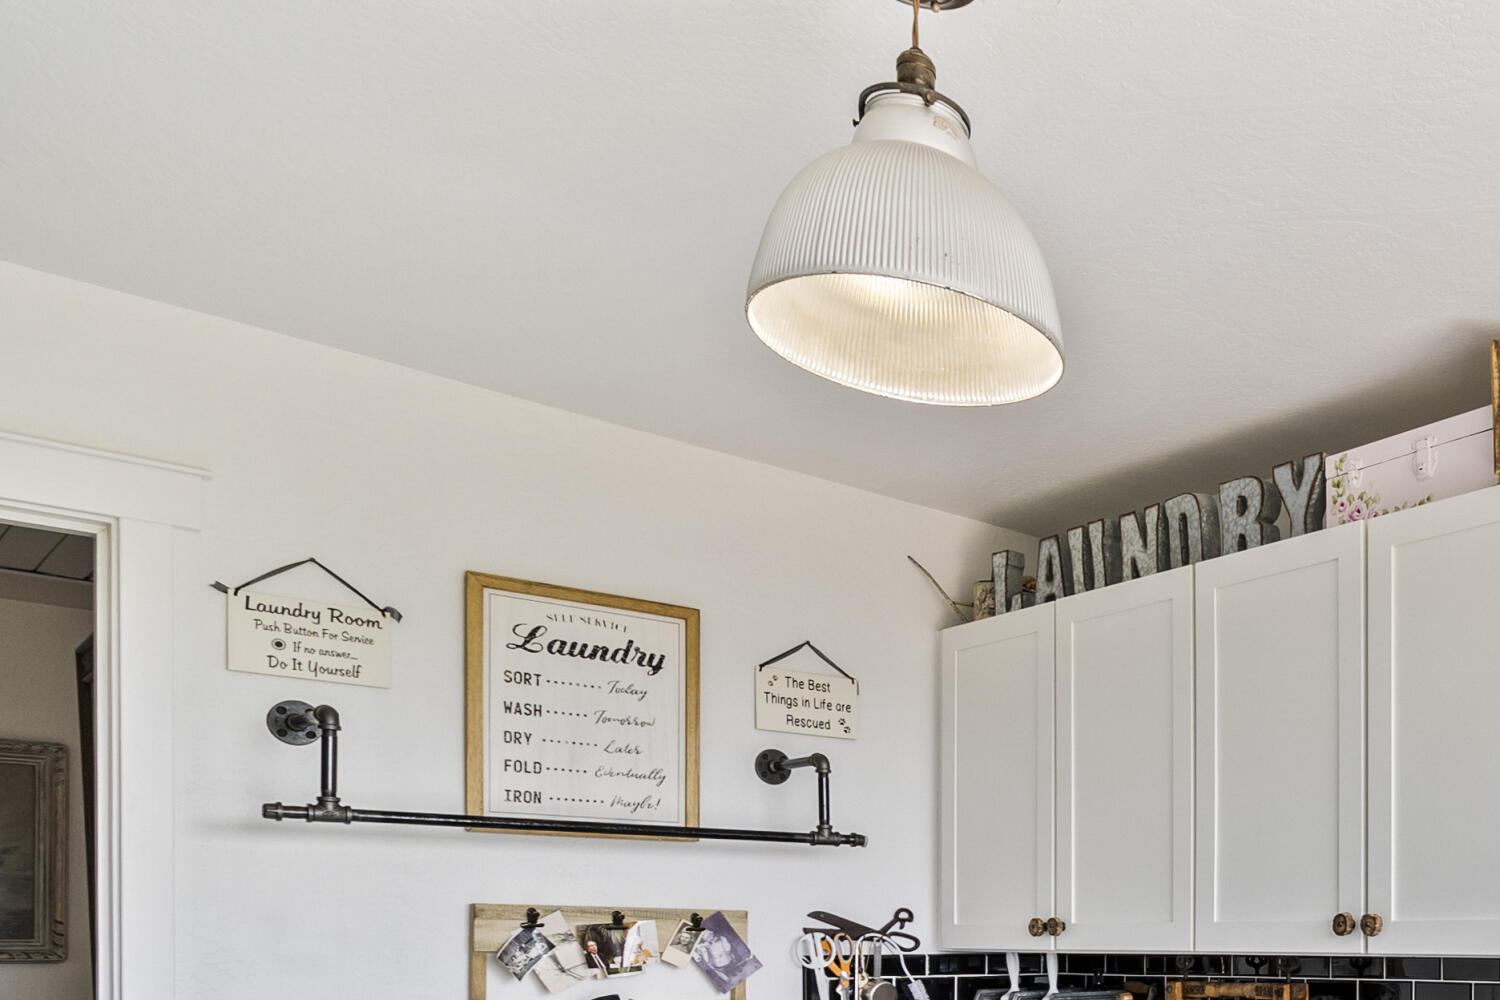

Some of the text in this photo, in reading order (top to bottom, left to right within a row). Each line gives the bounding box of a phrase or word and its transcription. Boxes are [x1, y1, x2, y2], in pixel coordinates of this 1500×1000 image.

[992, 452, 1325, 616] LAUNDRY
[245, 595, 383, 630] Laundry Room
[253, 618, 375, 646] Push Button For Service
[293, 641, 302, 653] If
[304, 647, 315, 655] no
[506, 623, 666, 676] Laundry
[267, 655, 362, 679] Do It Yourself
[503, 670, 648, 701] SORT Today
[785, 676, 831, 693] The Best
[503, 700, 656, 727] WASH Tomorrow
[764, 691, 852, 713] Things in Life are
[786, 714, 831, 730] Rescued
[503, 730, 643, 755] DRY Later
[503, 759, 666, 786] FOLD Eventually
[504, 789, 542, 804] IRON
